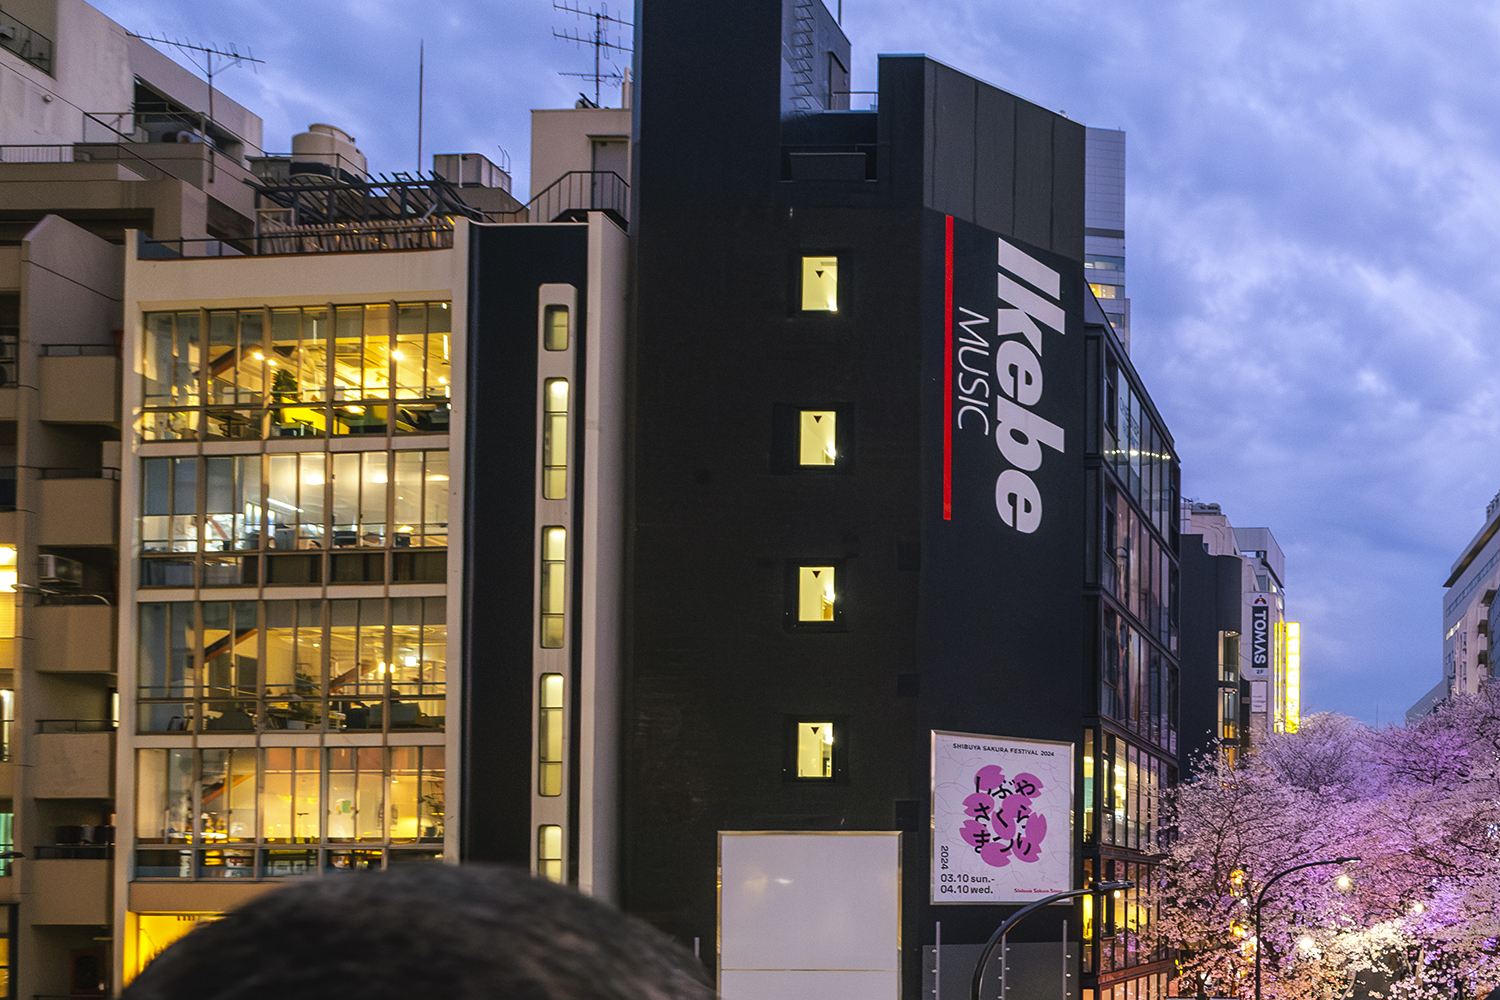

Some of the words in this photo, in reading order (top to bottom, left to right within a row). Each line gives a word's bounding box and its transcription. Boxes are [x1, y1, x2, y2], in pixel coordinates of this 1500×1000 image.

[957, 306, 990, 436] MUSIC
[995, 237, 1066, 534] Ikebe
[1254, 610, 1266, 664] TOMAS
[952, 743, 981, 751] SHIBUYA
[983, 745, 1009, 753] SAKURA
[1010, 747, 1038, 756] FESTIVAL
[975, 776, 1036, 799] しぶや
[973, 802, 1030, 829] さくら
[973, 830, 1032, 856] まつり
[940, 845, 949, 870] 2024
[940, 873, 969, 883] 03.10
[940, 885, 969, 894] 04.10
[970, 885, 993, 894] wed.
